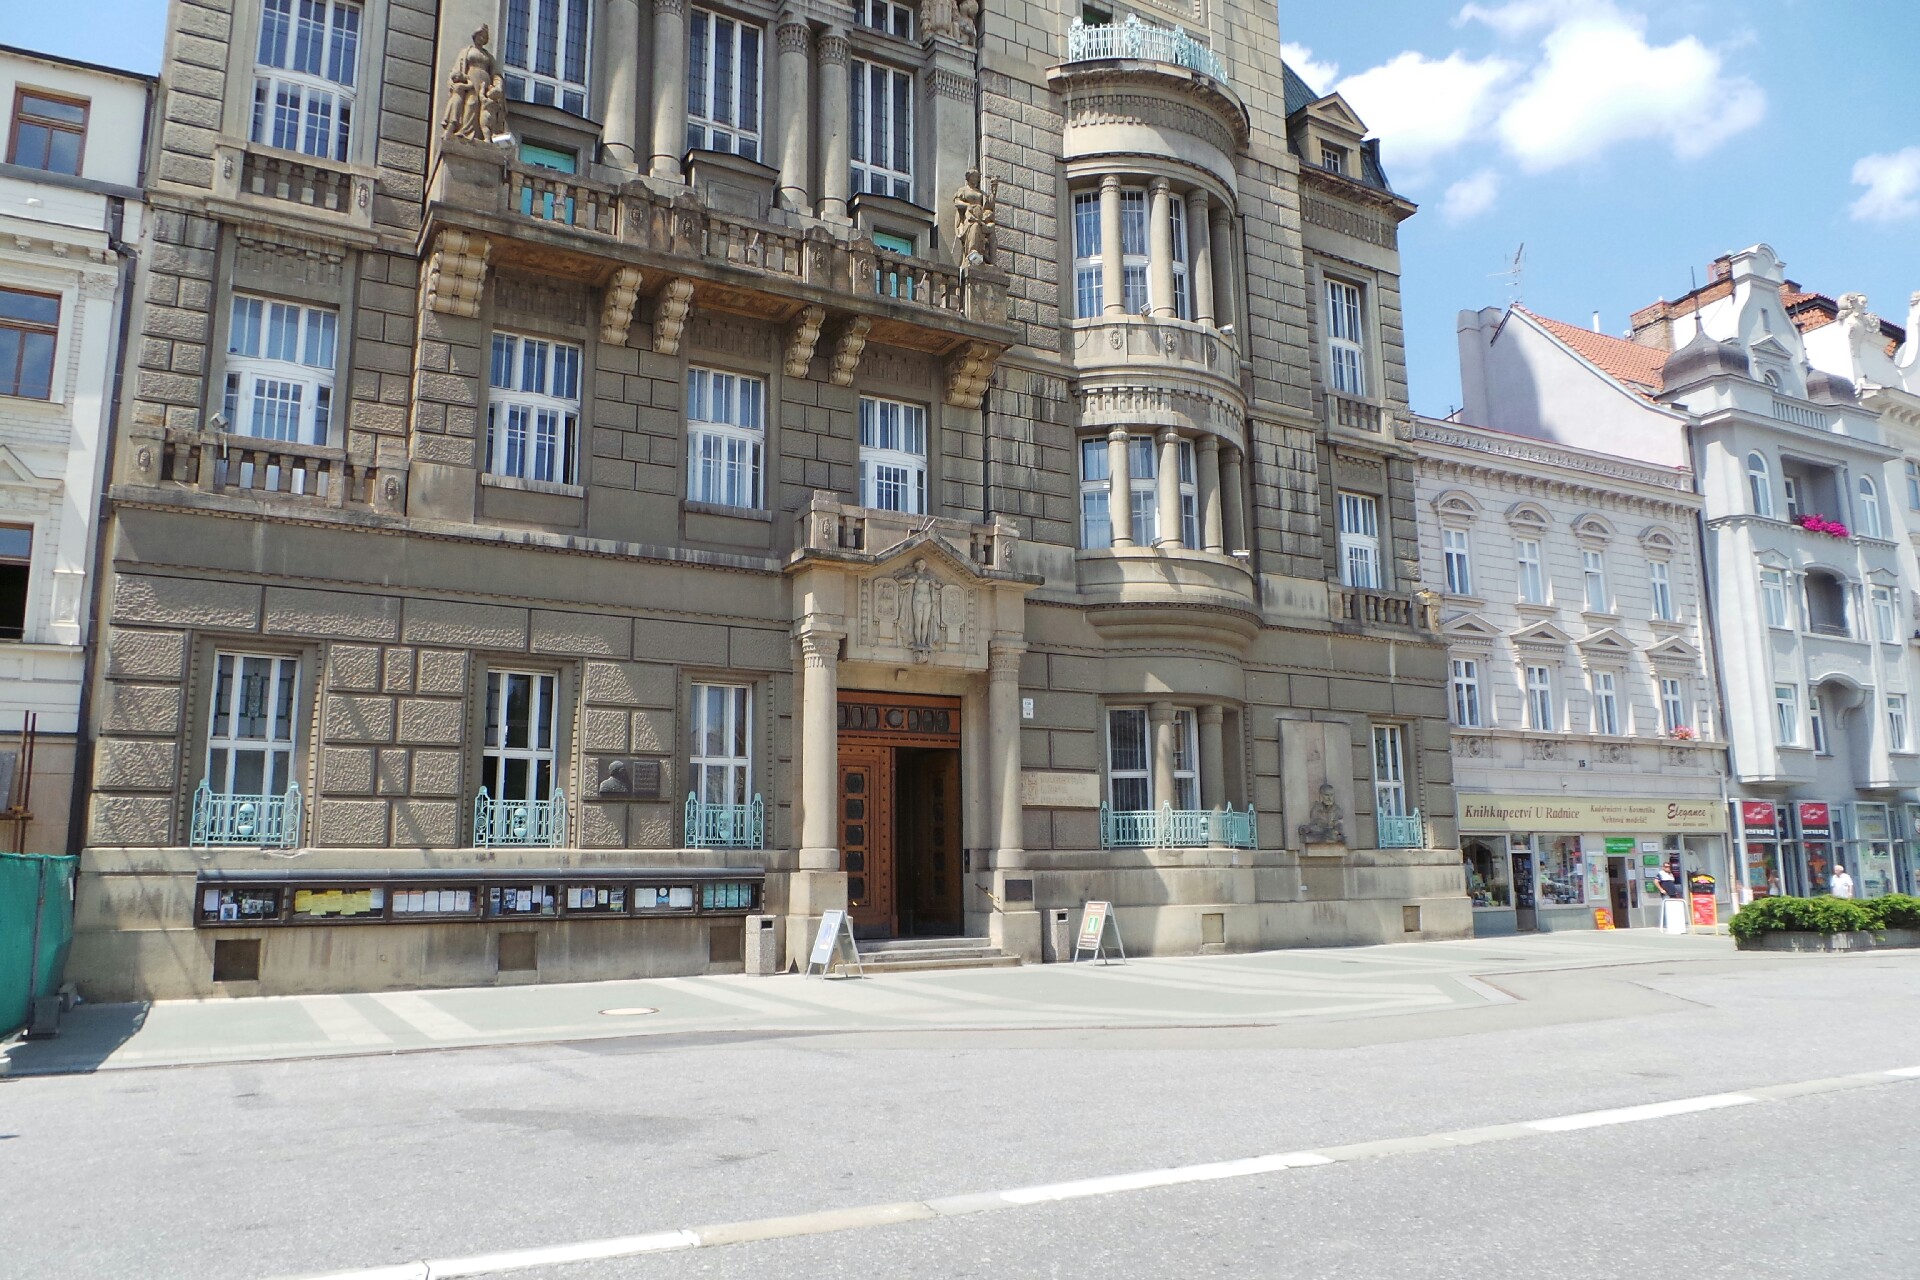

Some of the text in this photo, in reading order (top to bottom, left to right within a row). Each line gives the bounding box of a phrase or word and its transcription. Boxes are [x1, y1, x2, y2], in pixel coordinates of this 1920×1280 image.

[1465, 805, 1580, 820] Knihkupectví U Radnice
[1667, 803, 1706, 819] Elegance
